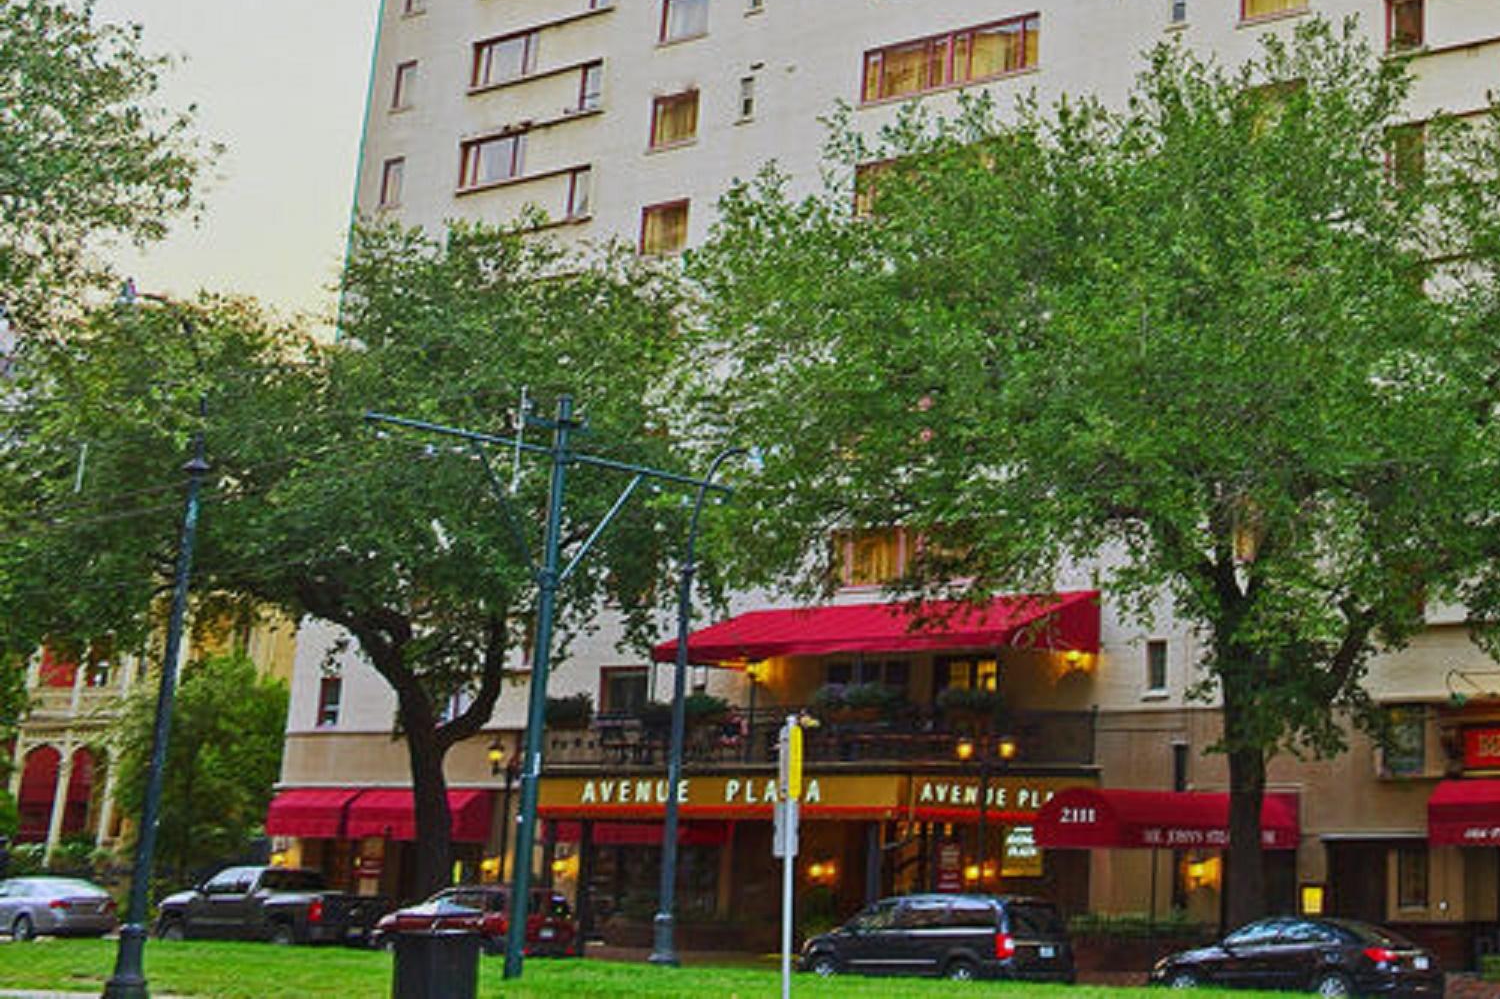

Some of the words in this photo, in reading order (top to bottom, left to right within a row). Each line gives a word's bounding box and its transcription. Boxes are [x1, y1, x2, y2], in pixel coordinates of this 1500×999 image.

[581, 779, 690, 803] AVENUE
[725, 779, 820, 803] PLAA
[920, 782, 1007, 808] AVENUE
[1059, 807, 1096, 824] 2111
